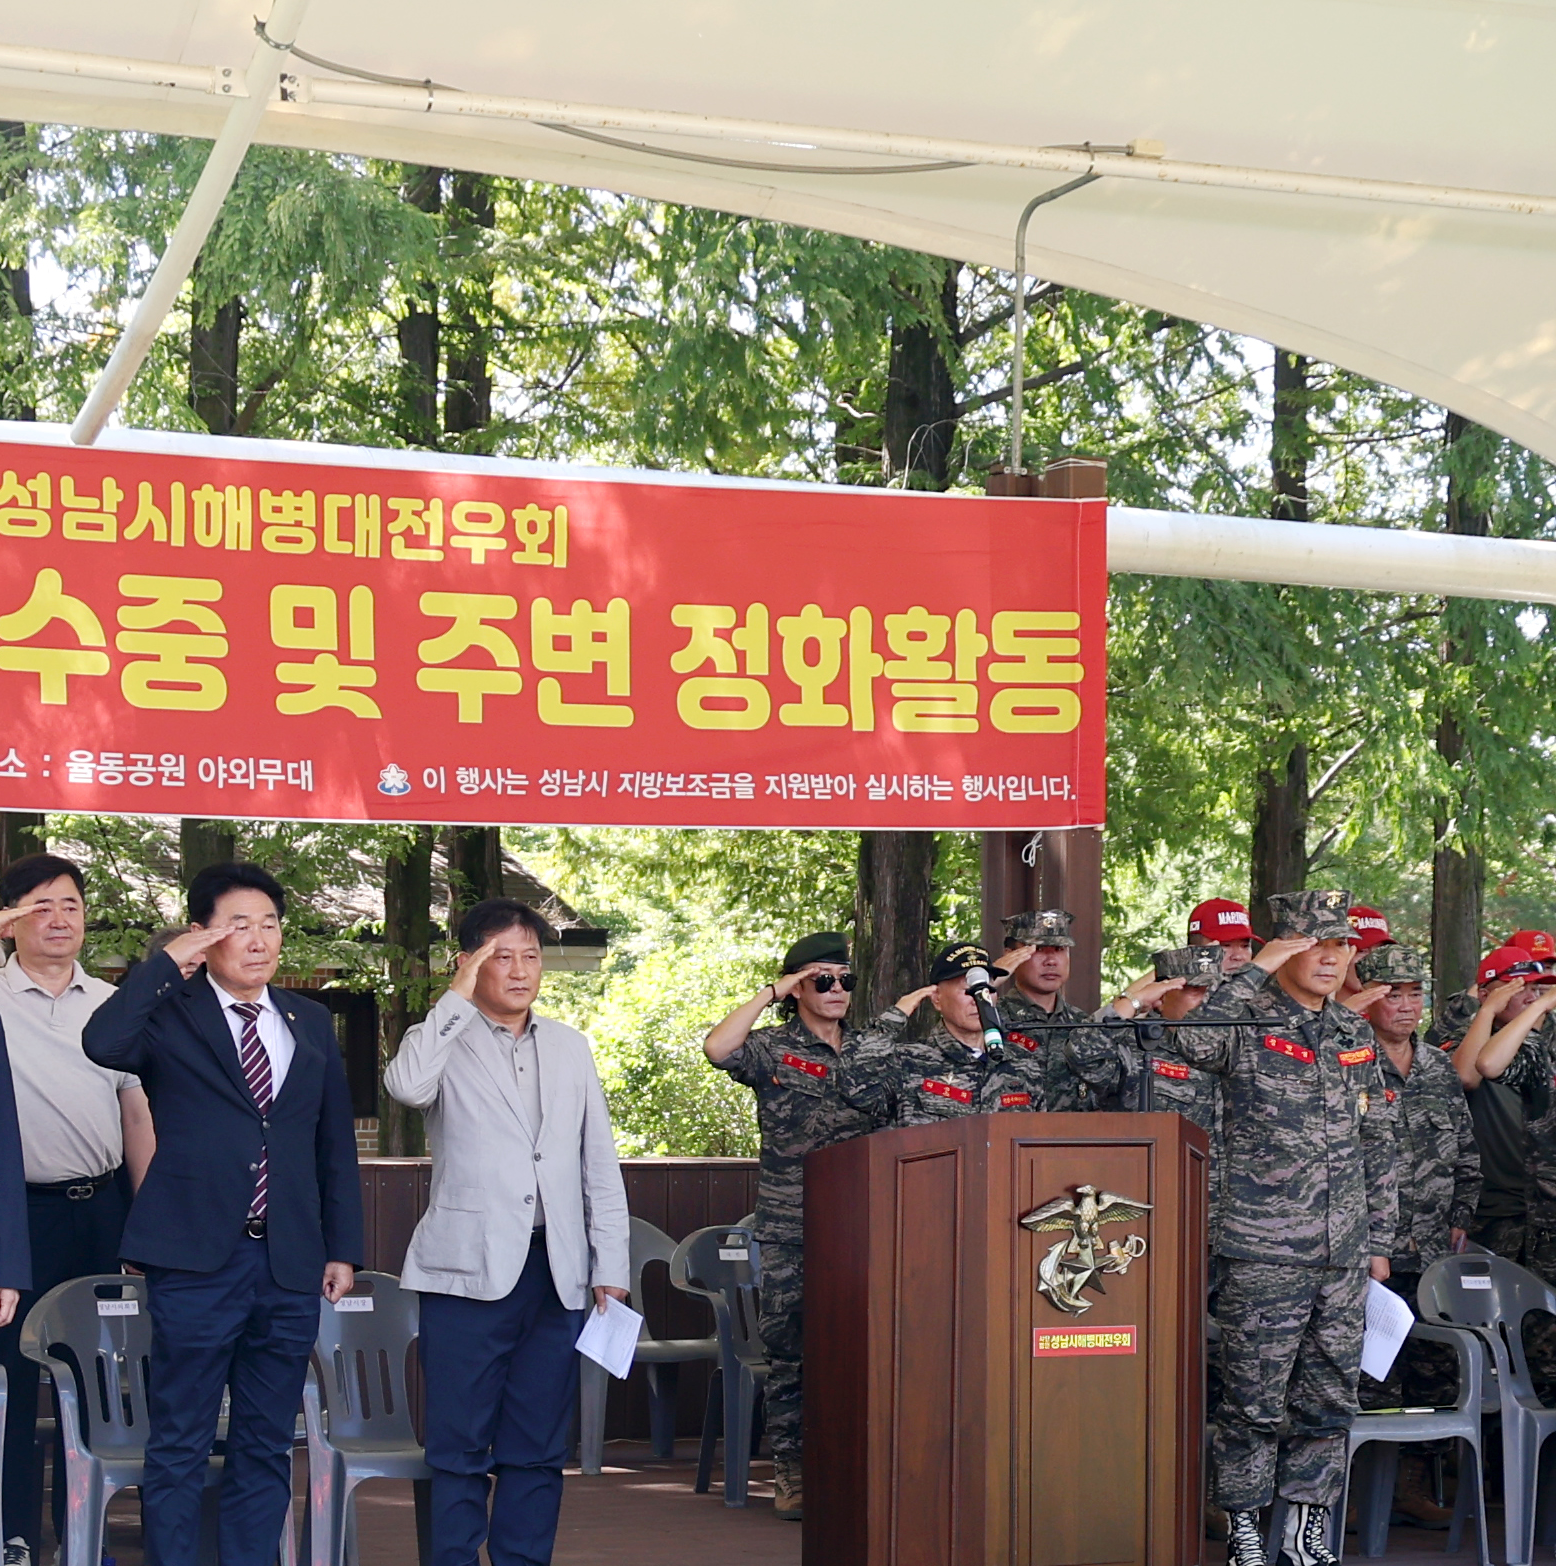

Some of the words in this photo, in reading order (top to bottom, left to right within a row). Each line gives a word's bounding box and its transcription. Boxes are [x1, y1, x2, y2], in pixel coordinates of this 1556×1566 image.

[269, 584, 383, 719] 및
[416, 591, 635, 728] 주변
[670, 602, 1085, 735] 정화활동
[64, 749, 186, 787] 율동공원
[197, 755, 314, 793] 야외무대
[422, 765, 447, 794] 이
[454, 767, 530, 796] 행사는
[538, 768, 609, 798] 성남시
[616, 771, 756, 800] 지방보조금을
[764, 773, 857, 801] 지원받아
[864, 773, 955, 801] 실시하는
[960, 775, 1077, 803] 행사입니다.
